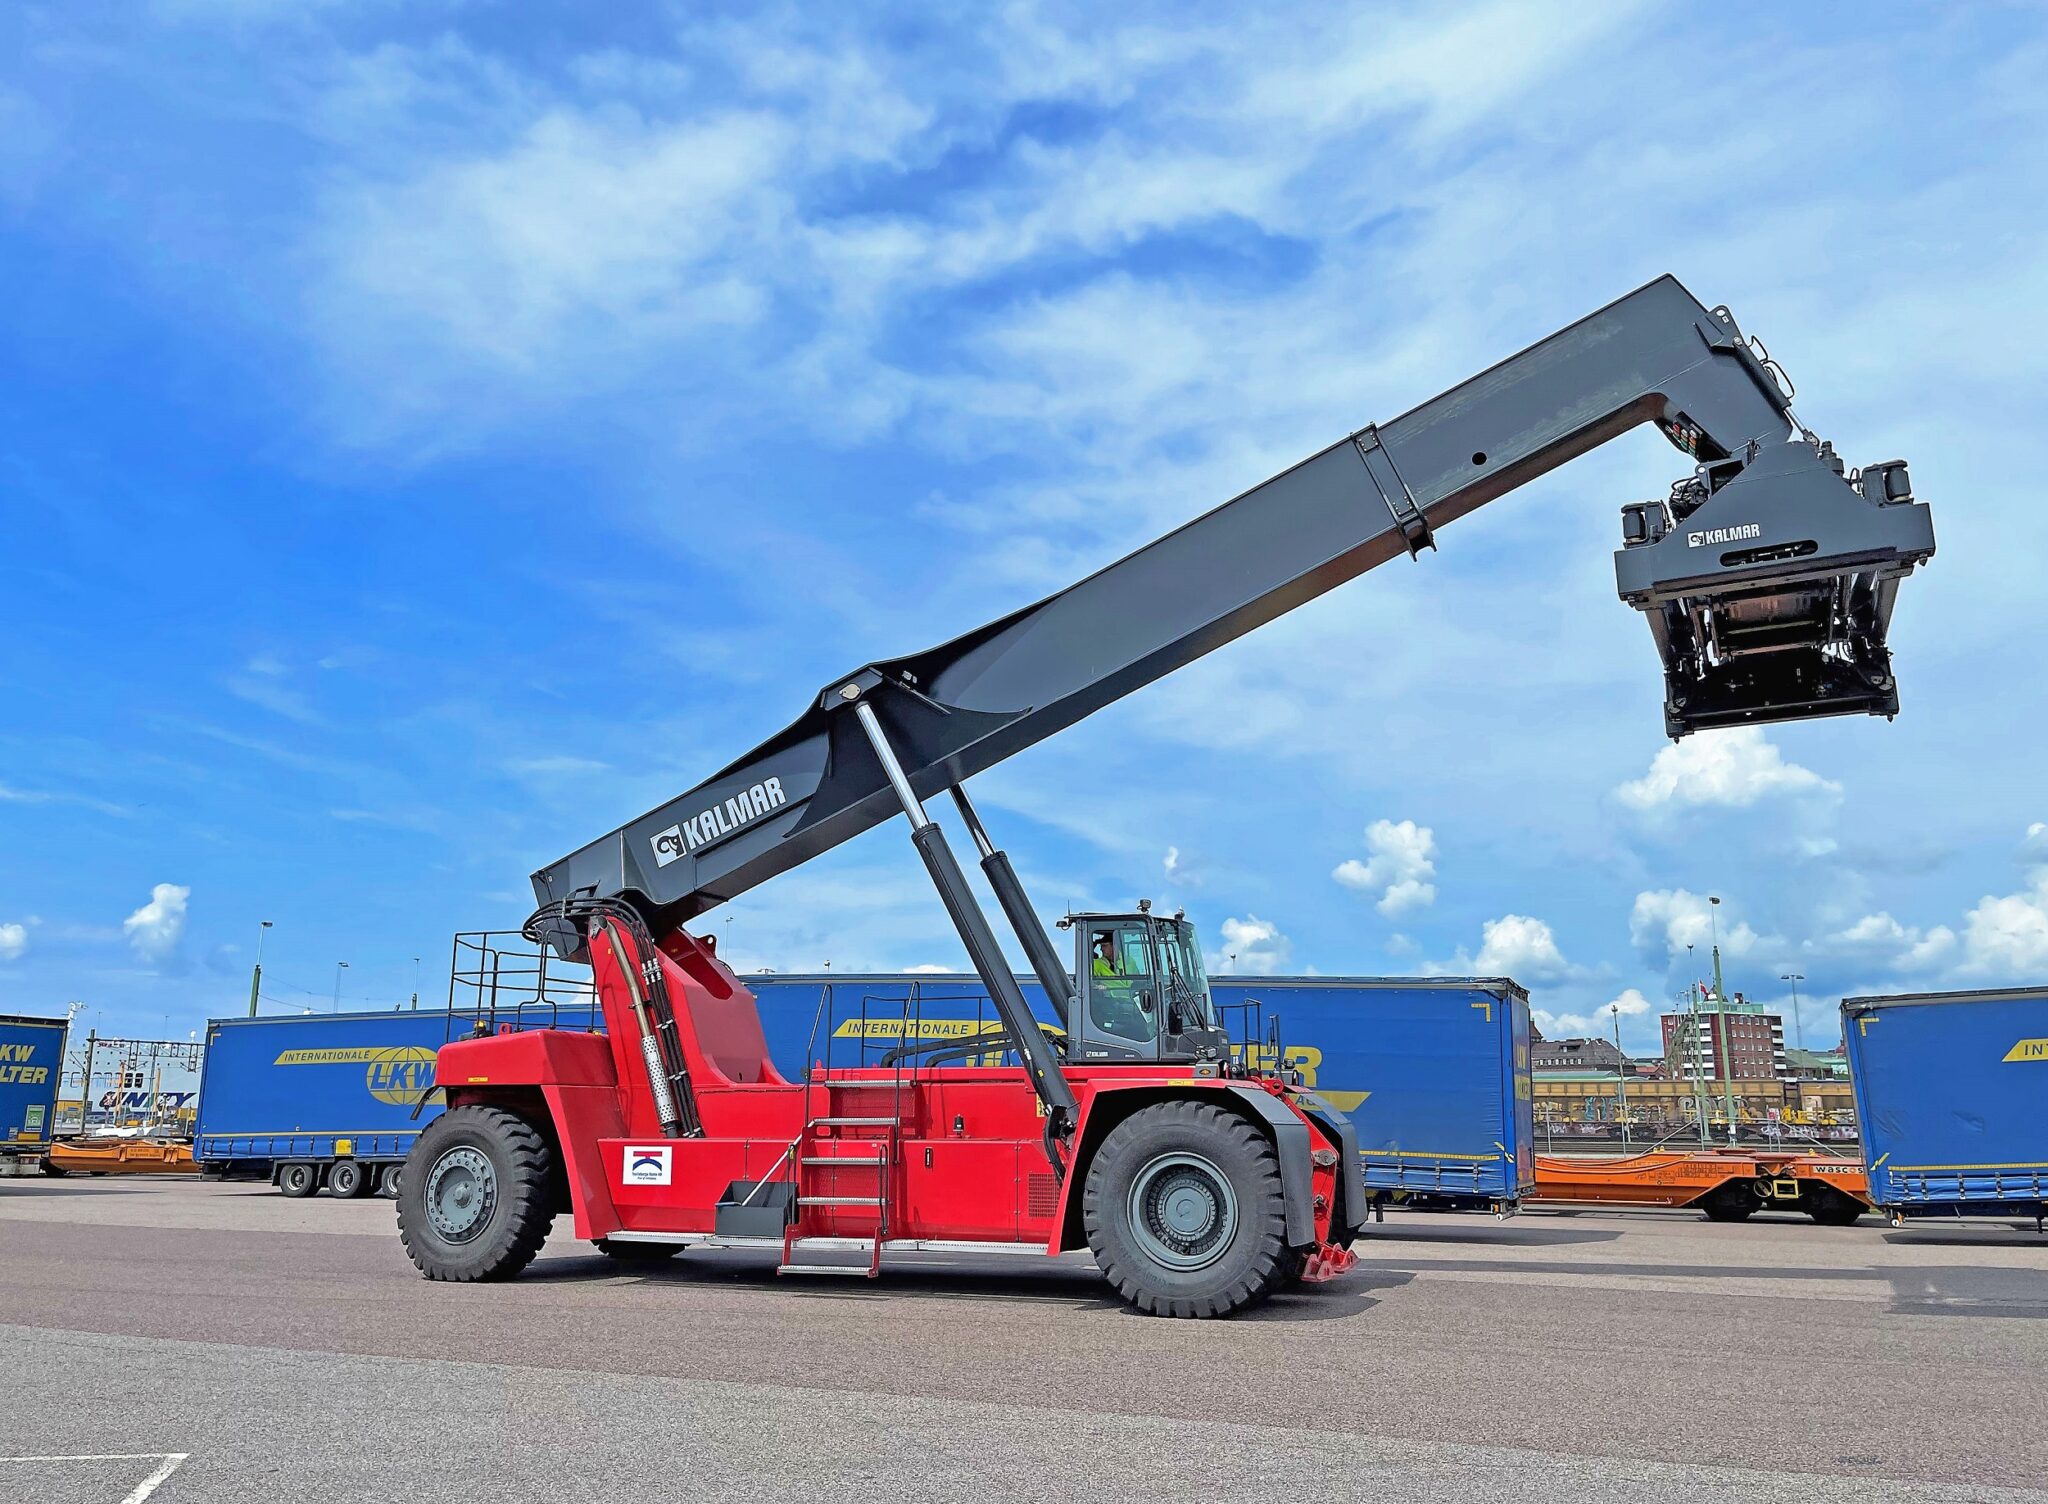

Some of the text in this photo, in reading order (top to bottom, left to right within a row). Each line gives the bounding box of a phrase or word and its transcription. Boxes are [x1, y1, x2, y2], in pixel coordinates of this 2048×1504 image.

[1705, 523, 1760, 545] KALMAR
[682, 776, 786, 850] KALMAR
[848, 1023, 969, 1035] INTERNTONALE
[285, 1050, 370, 1062] INTERNATIONALE
[2025, 1043, 2048, 1055] IN
[370, 1062, 437, 1090] LKW
